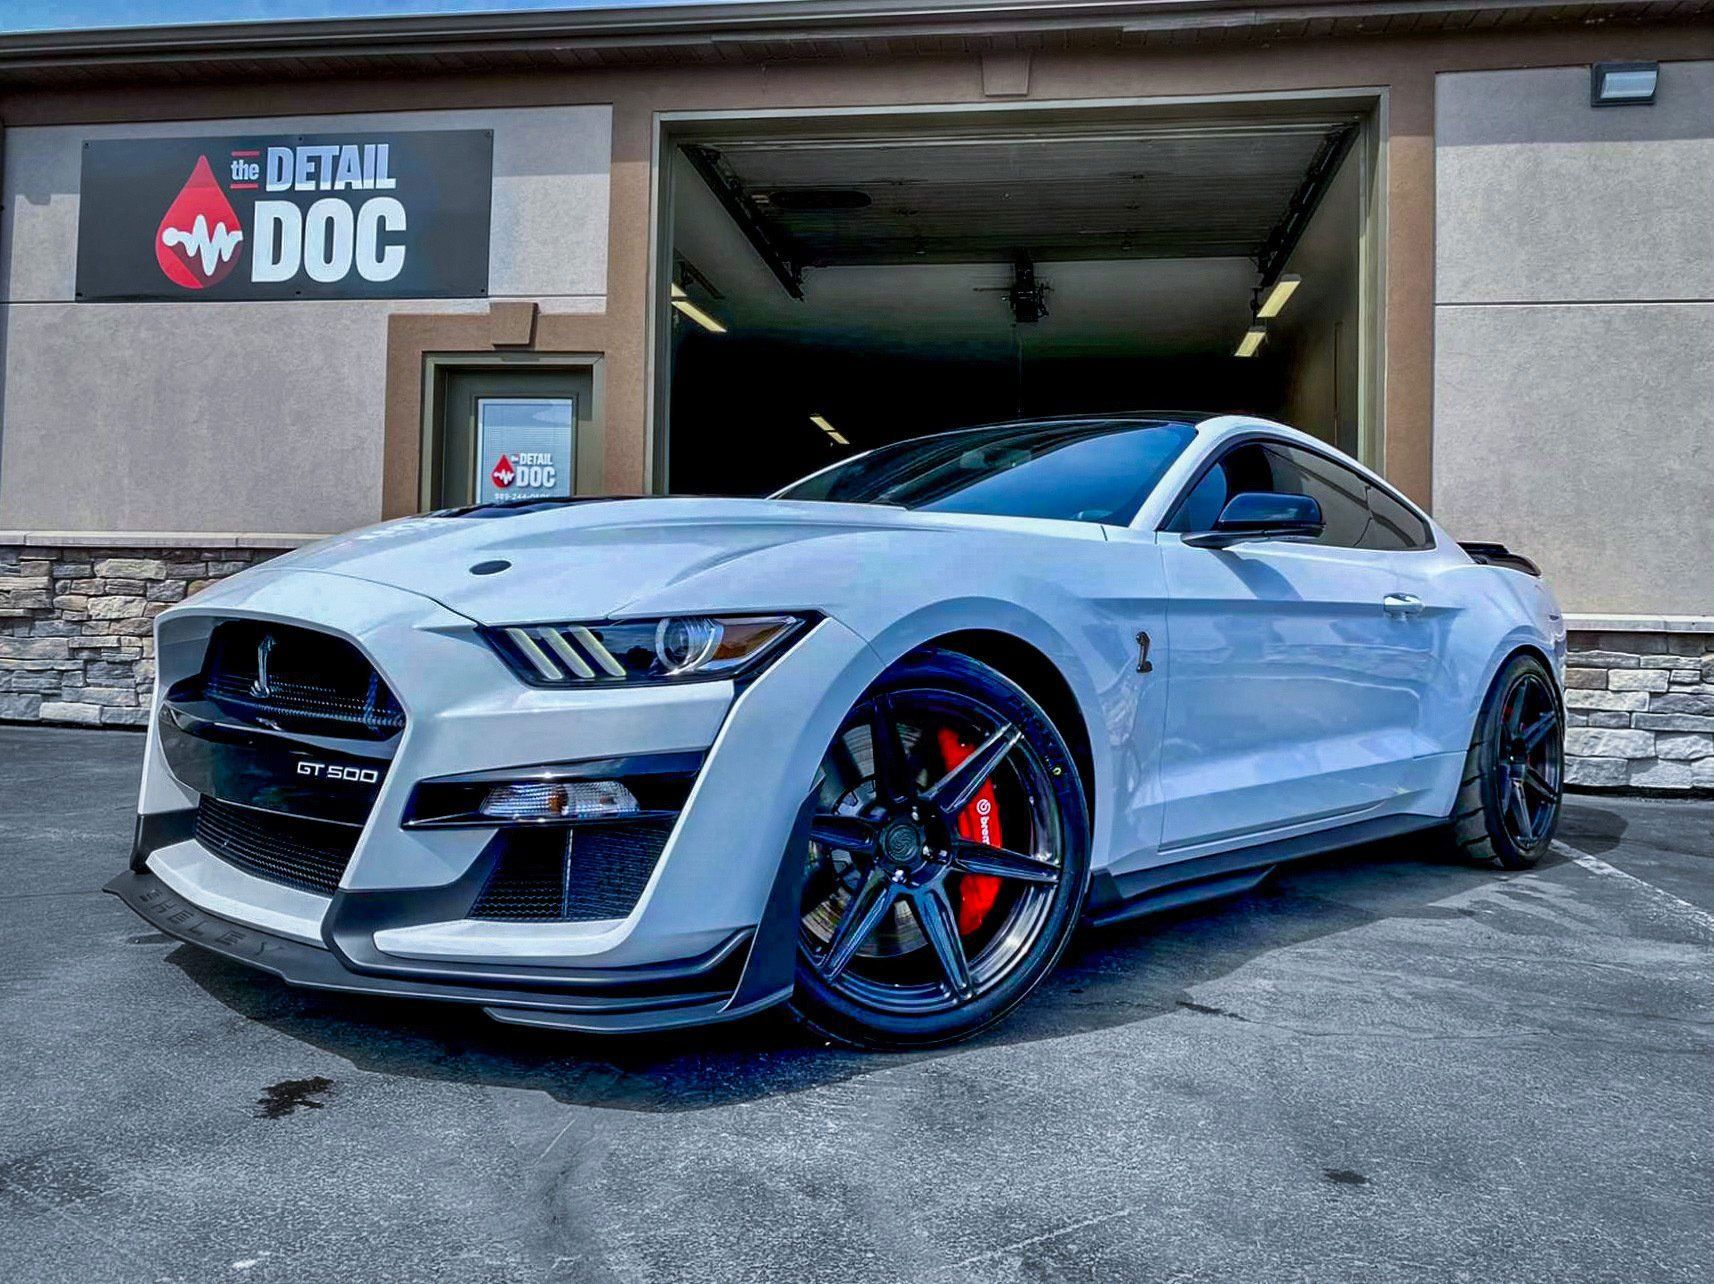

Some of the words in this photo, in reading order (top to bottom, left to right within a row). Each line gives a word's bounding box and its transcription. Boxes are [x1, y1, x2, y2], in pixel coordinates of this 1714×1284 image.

[230, 159, 260, 181] the
[265, 143, 396, 192] DETAIL
[251, 196, 407, 283] DOC
[519, 452, 553, 465] DETAIL
[516, 466, 556, 487] DOC
[297, 761, 325, 776] GT
[327, 765, 379, 783] 500
